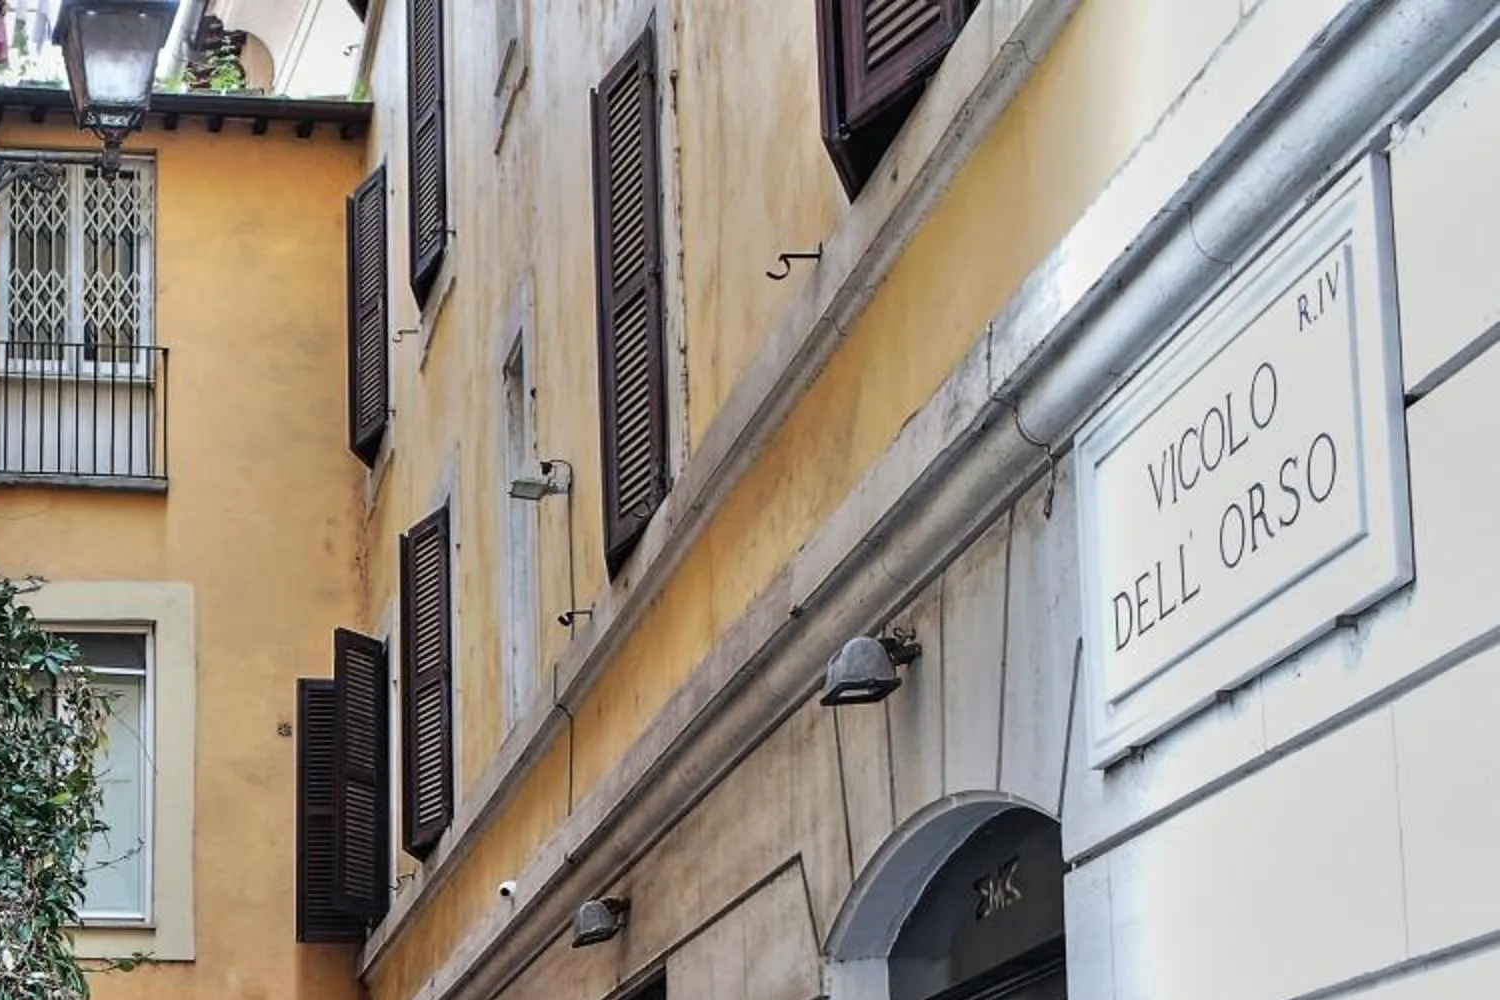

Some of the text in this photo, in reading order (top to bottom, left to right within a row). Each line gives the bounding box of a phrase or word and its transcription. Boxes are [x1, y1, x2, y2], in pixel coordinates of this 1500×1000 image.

[1146, 361, 1279, 511] VICOLO
[1111, 431, 1339, 653] DELL' ORSO
